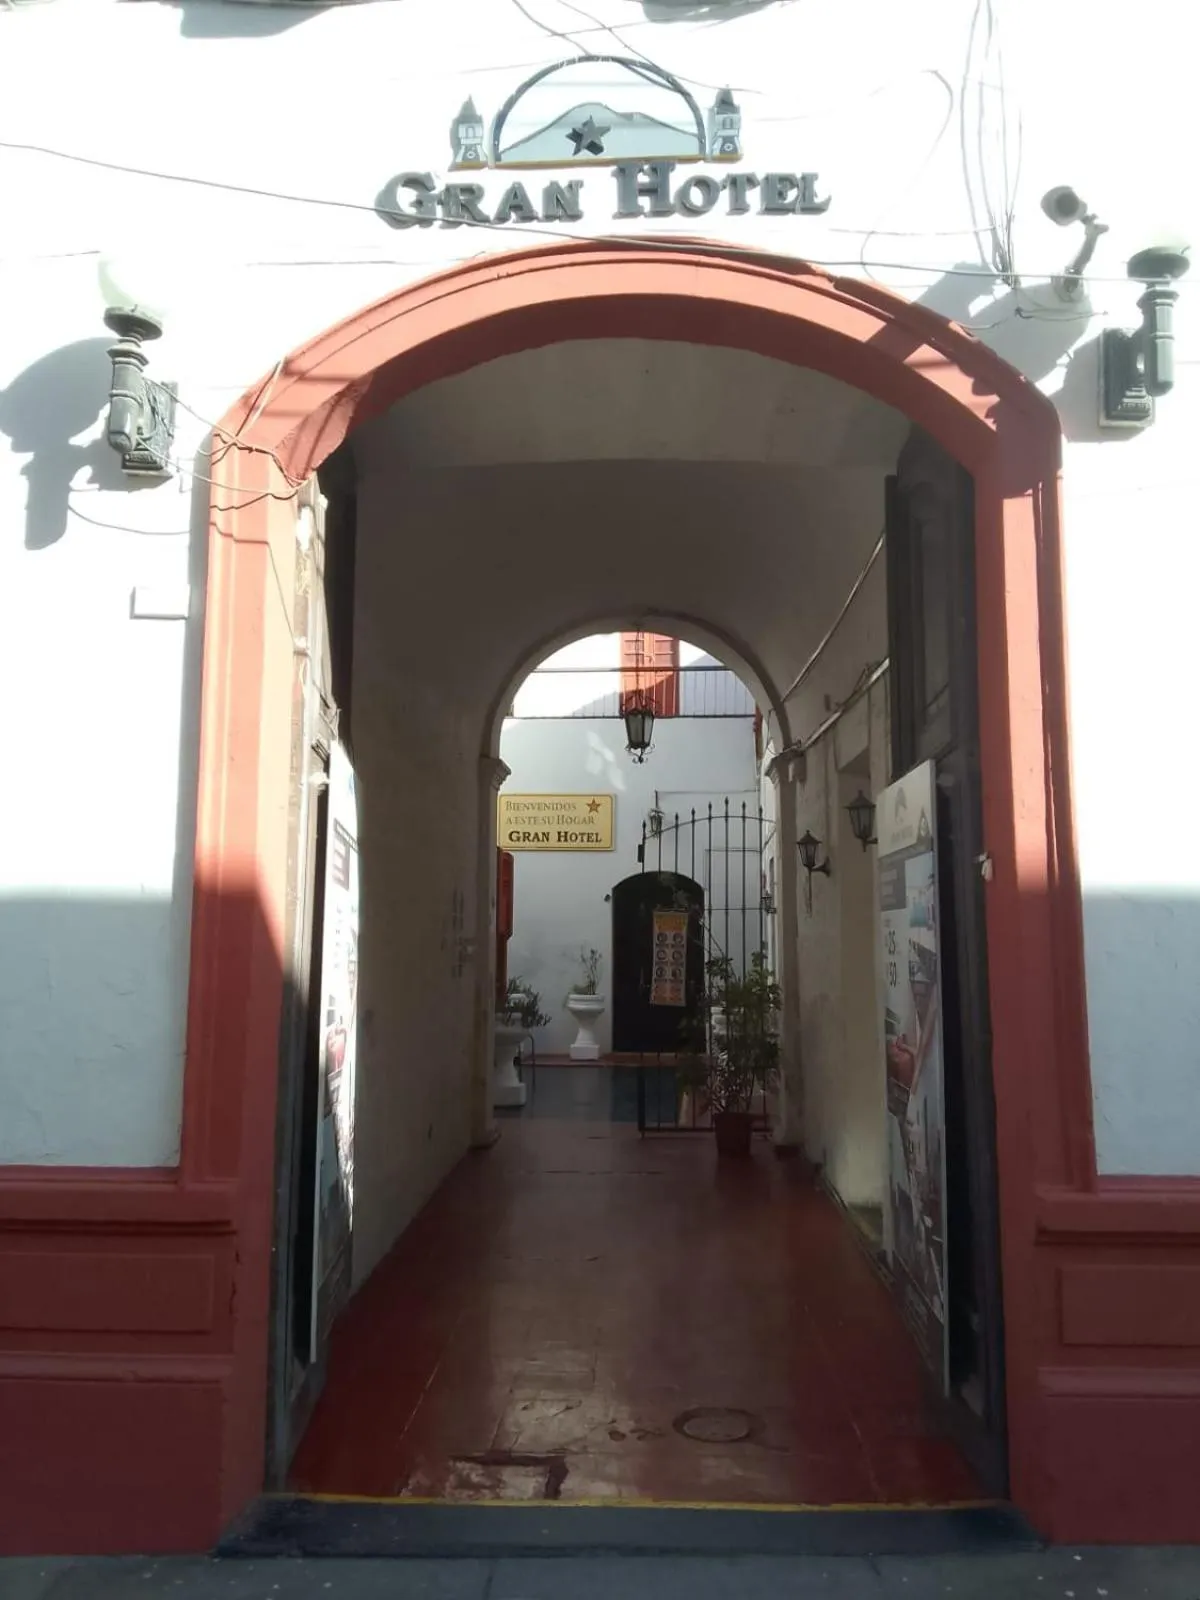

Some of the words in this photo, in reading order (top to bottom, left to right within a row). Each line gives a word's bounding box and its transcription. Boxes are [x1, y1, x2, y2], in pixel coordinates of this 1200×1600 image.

[375, 171, 584, 230] GRAN
[612, 161, 832, 220] HOTEL
[505, 801, 577, 812] BIENVENIDOS
[557, 814, 596, 825] HOGAR
[508, 831, 550, 843] GRAN
[557, 831, 602, 843] HOTEL
